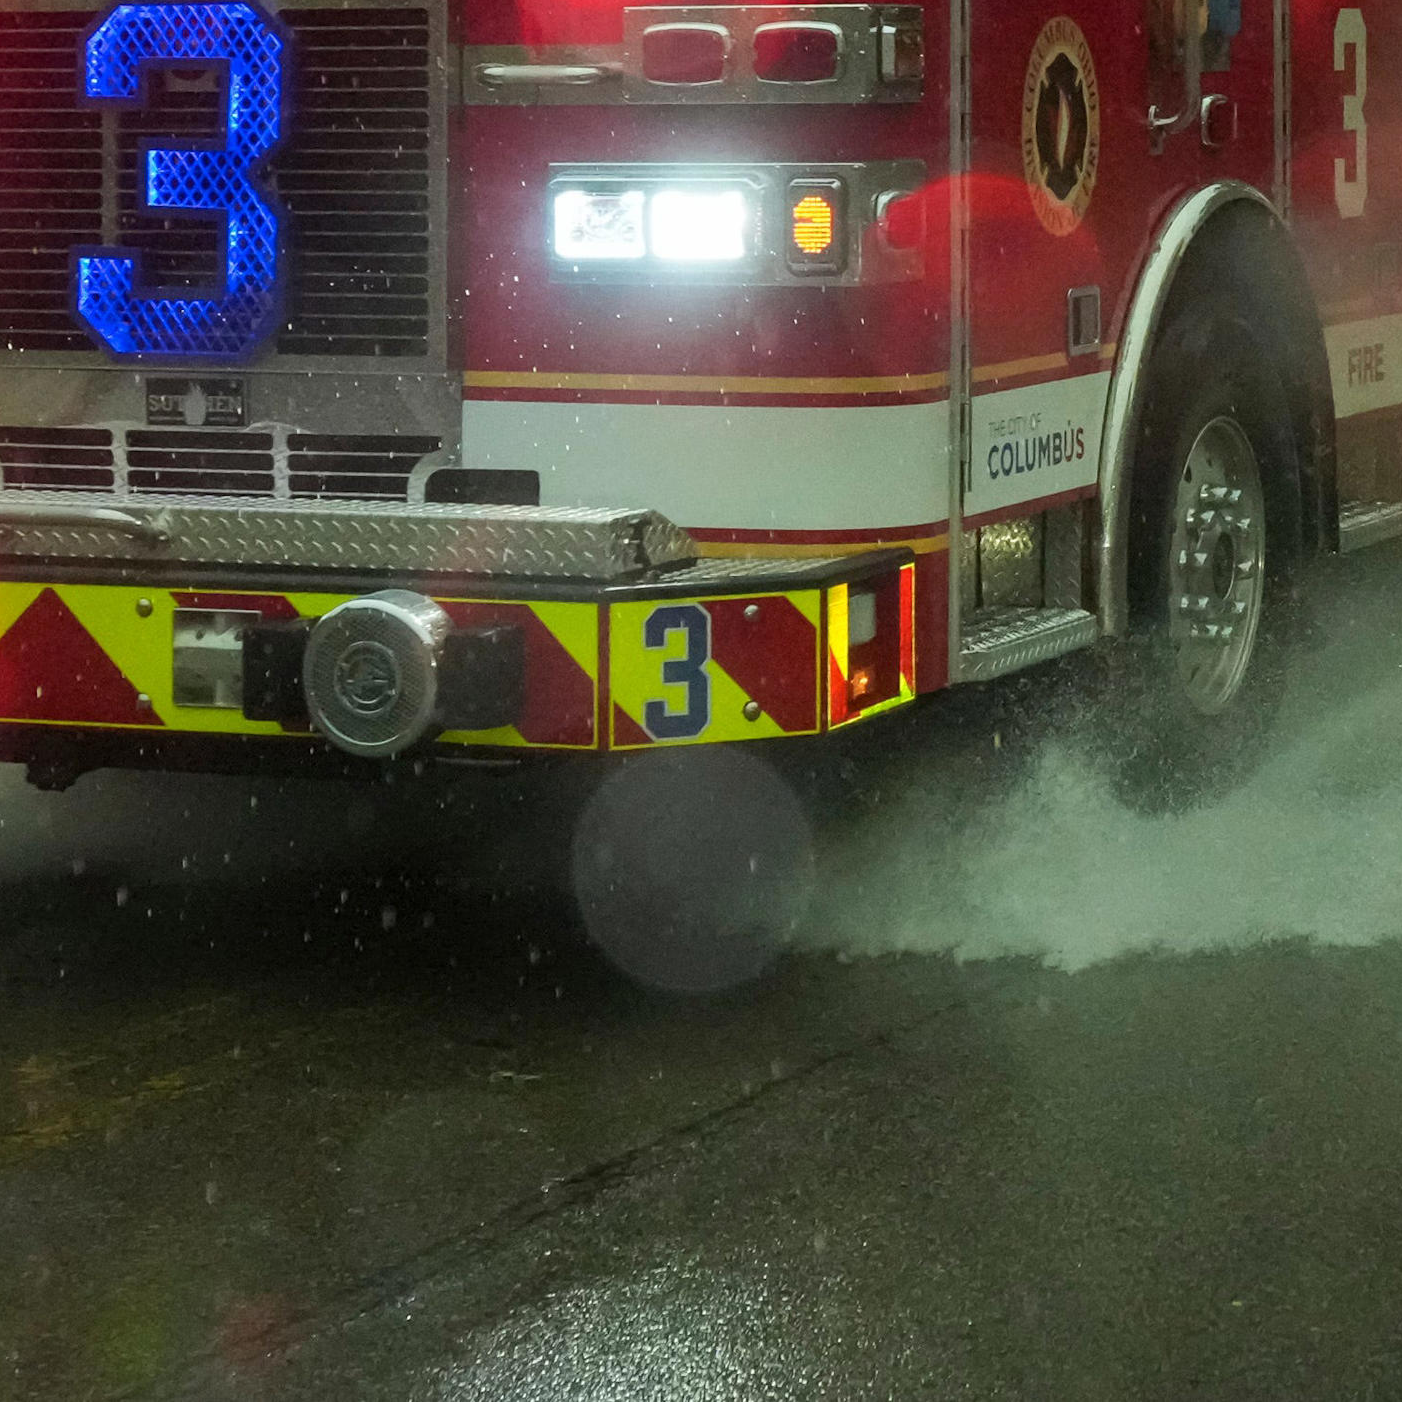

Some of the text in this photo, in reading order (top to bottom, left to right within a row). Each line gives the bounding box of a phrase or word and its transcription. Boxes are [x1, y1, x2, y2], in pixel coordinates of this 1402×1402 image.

[77, 1, 283, 355] 3
[1333, 8, 1368, 219] 3
[1348, 343, 1385, 387] FIRE
[987, 426, 1085, 480] COLUMBUS
[643, 601, 714, 742] 3
